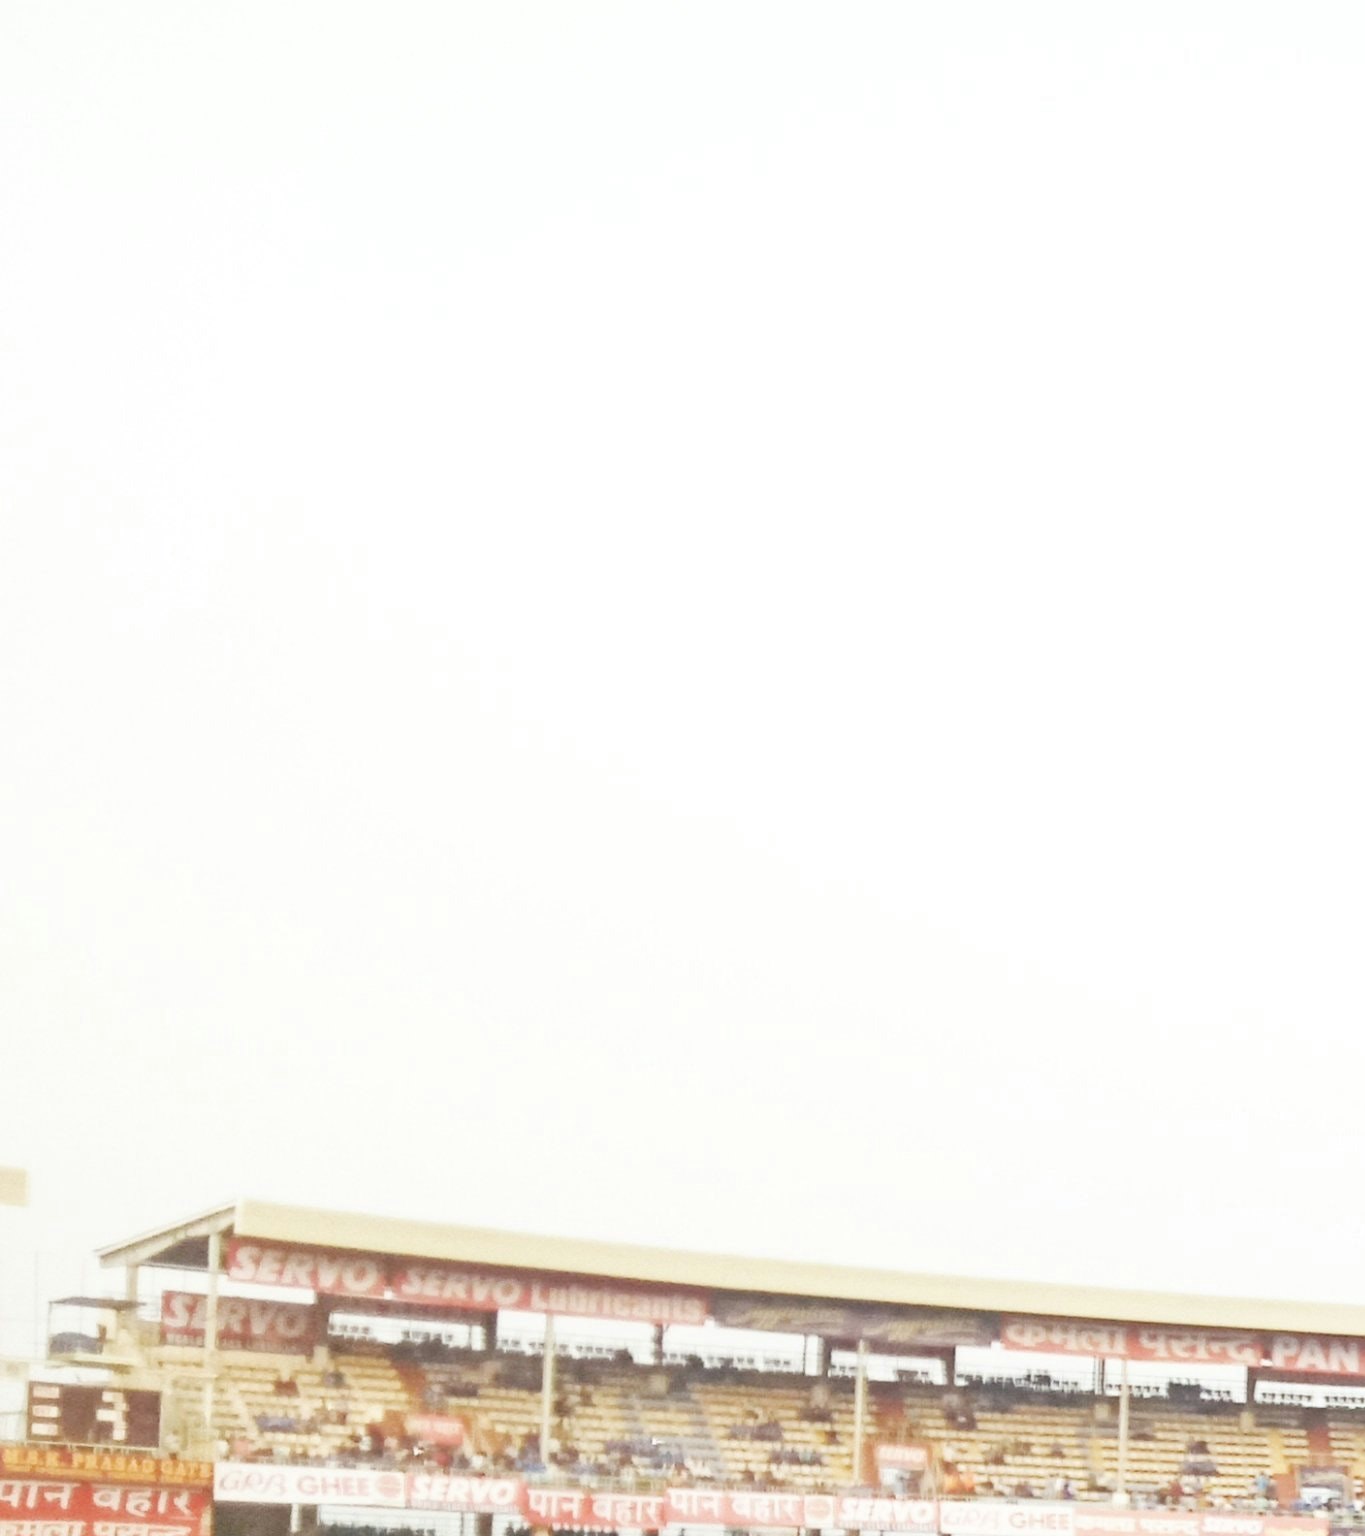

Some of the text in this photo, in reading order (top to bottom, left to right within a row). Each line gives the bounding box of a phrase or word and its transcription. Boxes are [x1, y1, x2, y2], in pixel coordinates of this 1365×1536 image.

[228, 1246, 380, 1292] SERVO
[401, 1268, 521, 1306] SERVO
[1272, 1335, 1359, 1373] PAN
[298, 1475, 370, 1496] GHEE
[412, 1476, 517, 1504] SERVO
[839, 1500, 935, 1523] SERVO
[1008, 1511, 1070, 1531] GHEE
